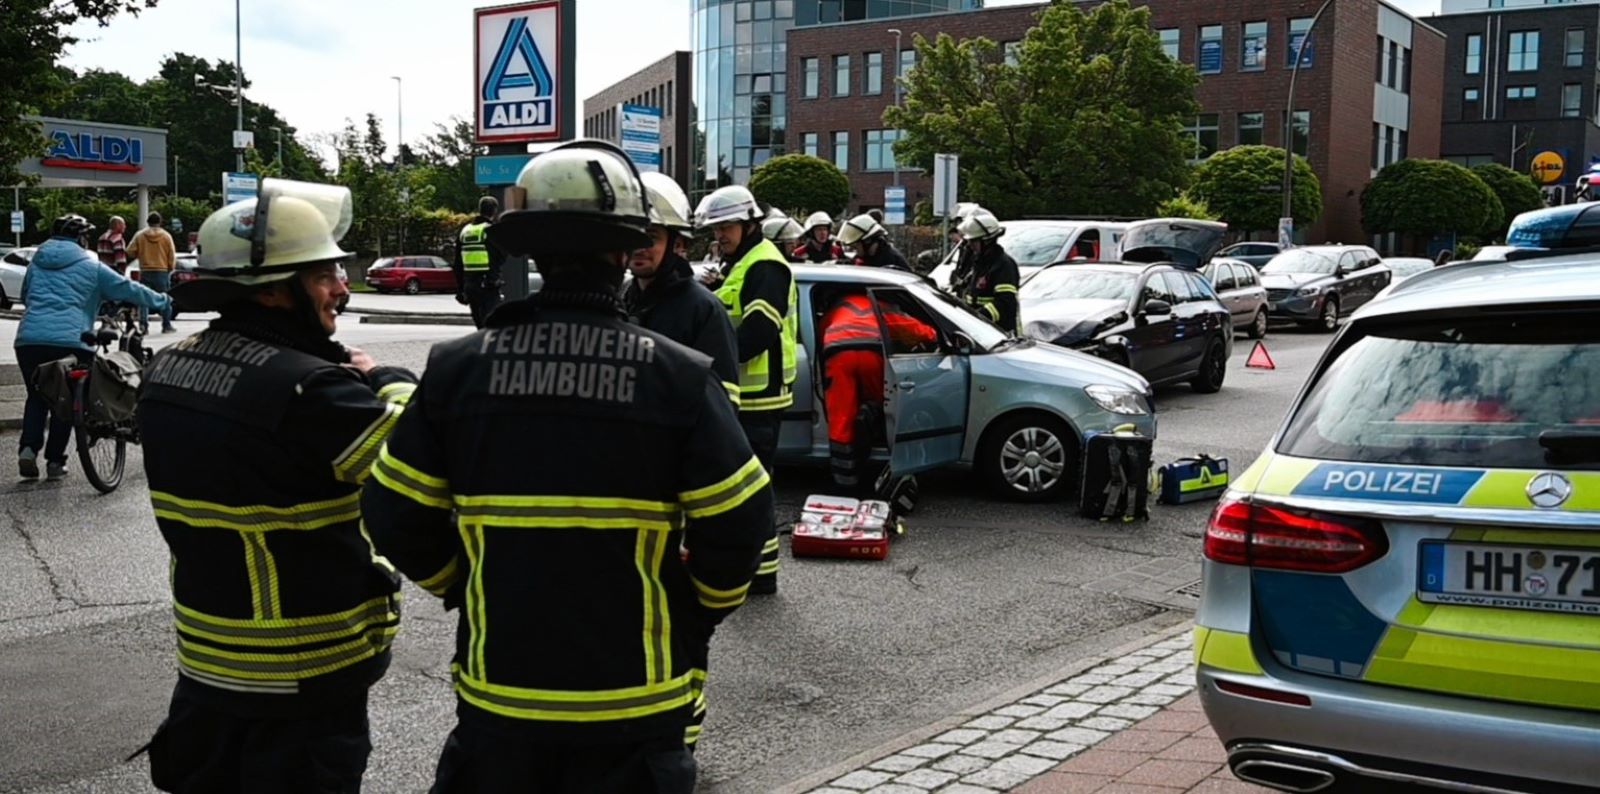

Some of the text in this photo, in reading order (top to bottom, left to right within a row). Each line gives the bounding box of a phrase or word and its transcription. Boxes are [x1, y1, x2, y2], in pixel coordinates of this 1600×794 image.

[489, 102, 546, 126] ALDI
[46, 129, 143, 165] ALDI
[480, 322, 656, 363] FEUERWEHR
[150, 354, 242, 397] HAMBURG
[488, 360, 636, 403] HAMBURG
[1323, 470, 1442, 495] POLIZEI
[1427, 574, 1436, 585] D
[1465, 550, 1522, 593] HH
